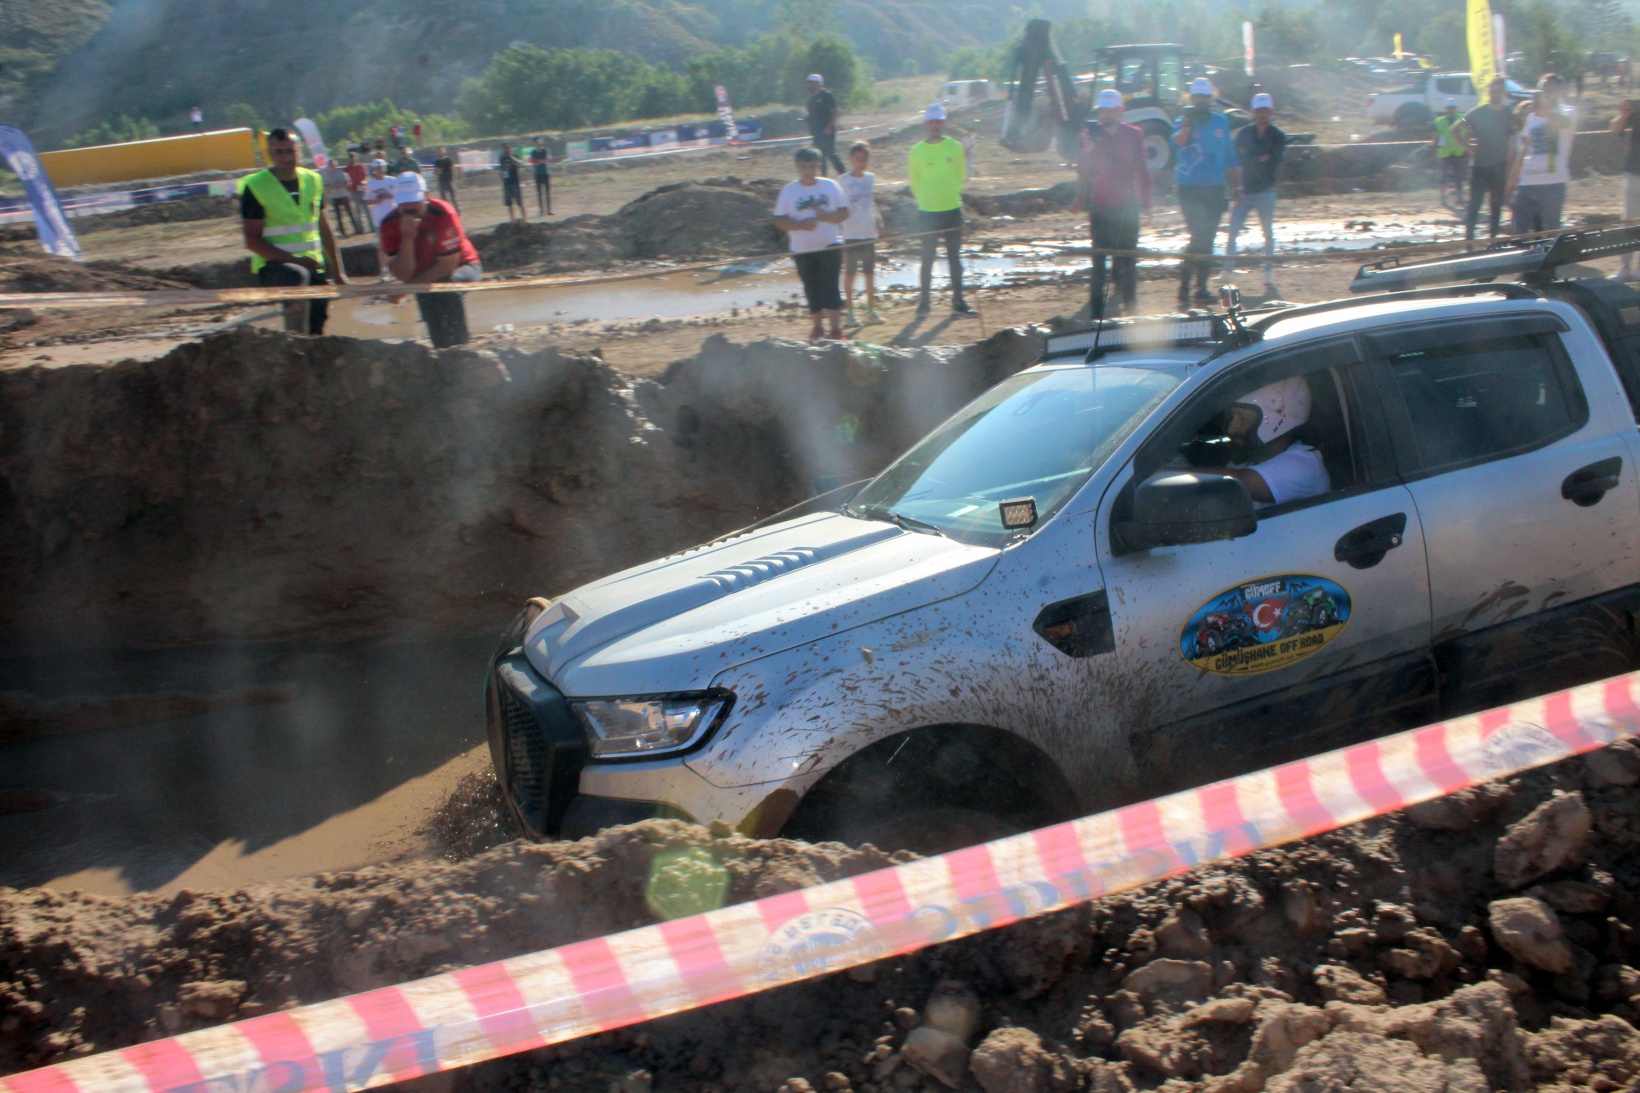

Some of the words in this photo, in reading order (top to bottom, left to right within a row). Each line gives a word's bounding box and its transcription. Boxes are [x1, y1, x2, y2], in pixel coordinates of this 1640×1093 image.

[1244, 581, 1281, 600] GÜMOFF
[1280, 640, 1298, 654] OFF
[1300, 633, 1324, 649] ROAD
